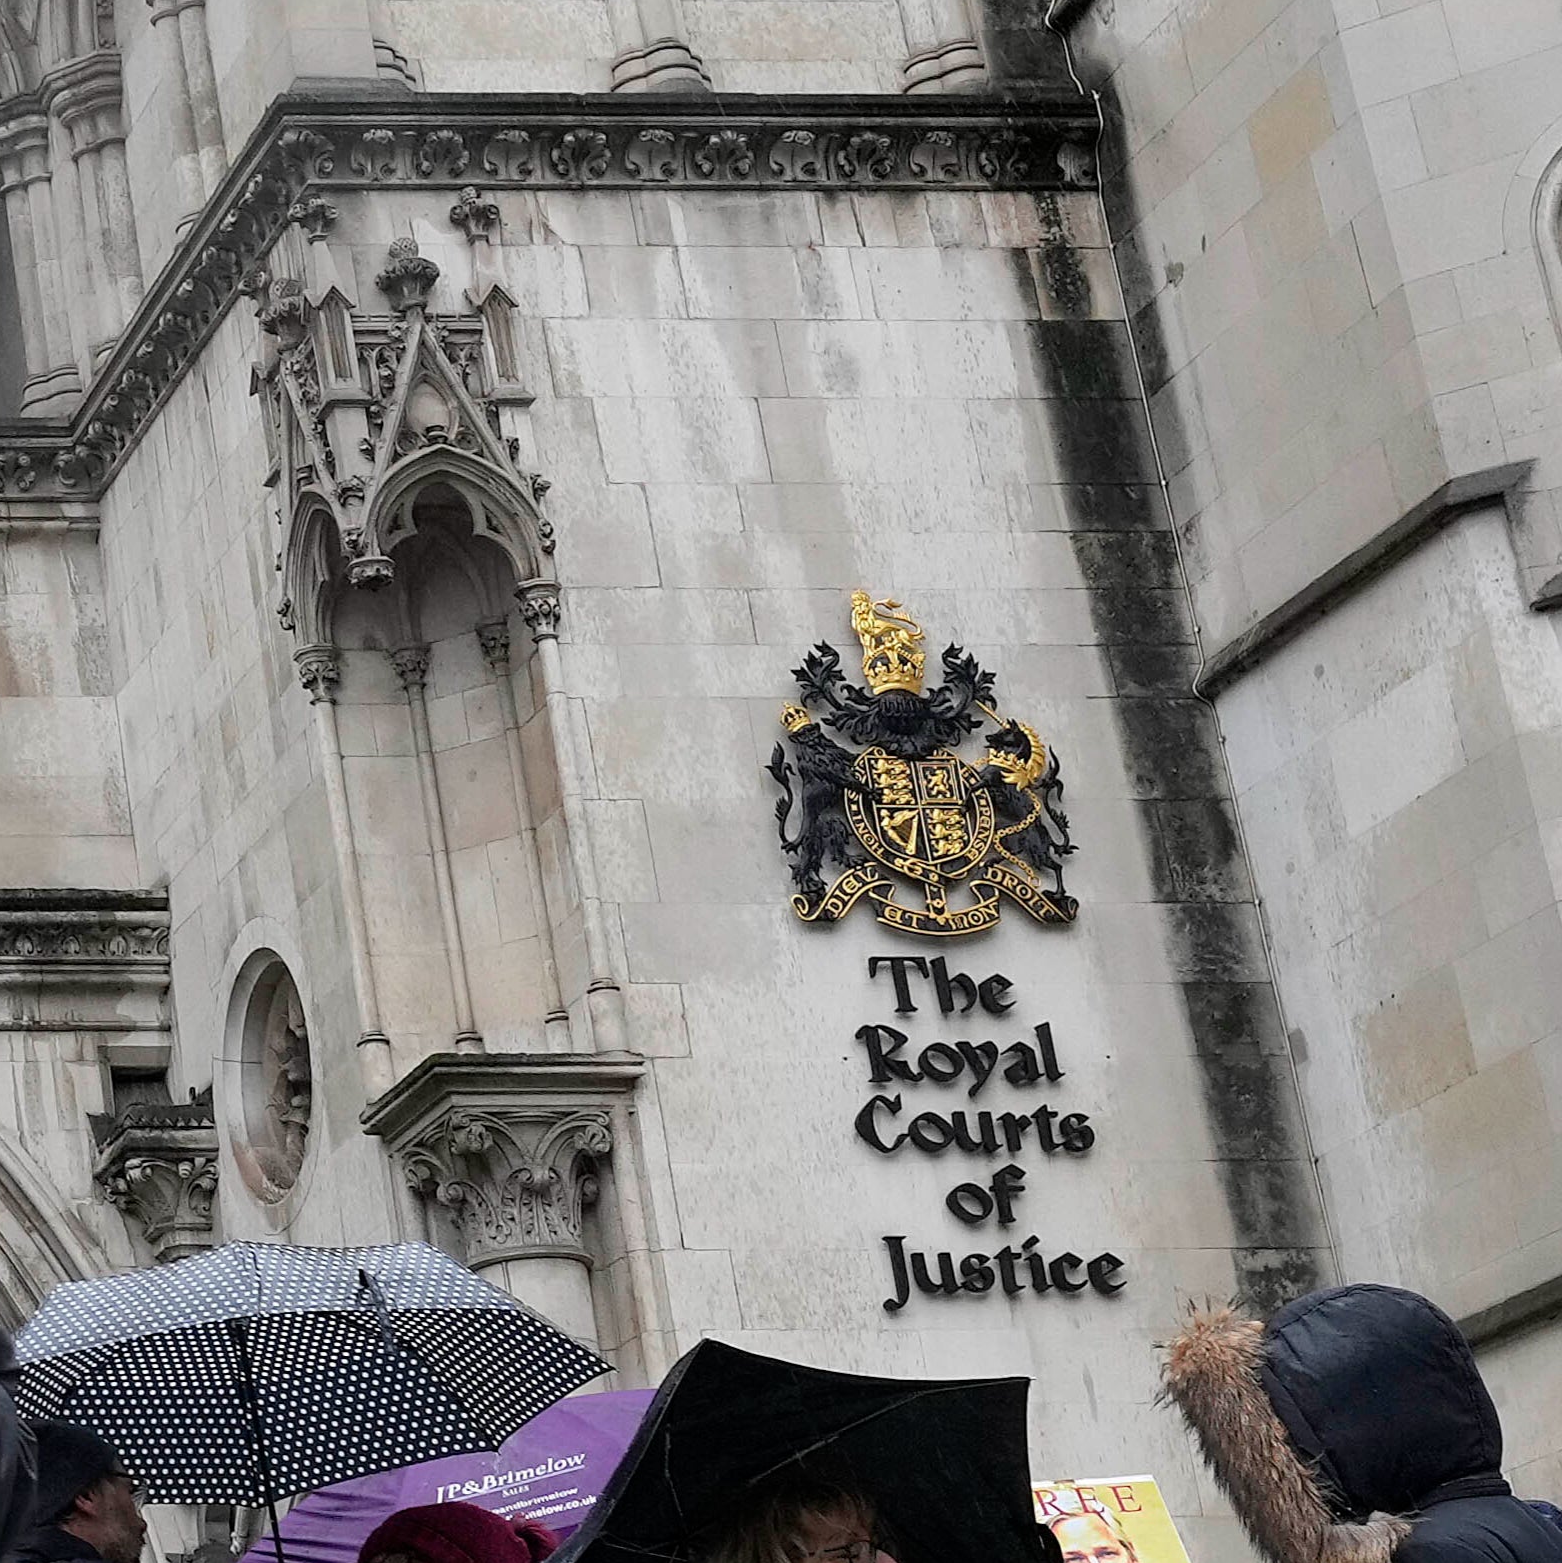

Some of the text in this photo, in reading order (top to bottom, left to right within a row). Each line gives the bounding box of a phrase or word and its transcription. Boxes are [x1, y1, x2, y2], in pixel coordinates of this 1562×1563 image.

[983, 865, 1054, 918] DROIT
[868, 955, 1017, 1015] The
[855, 1022, 1066, 1097] Royal
[855, 1094, 1095, 1154] Courts
[946, 1164, 1026, 1225] of
[881, 1234, 1128, 1312] Justice
[1034, 1485, 1143, 1517] REE
